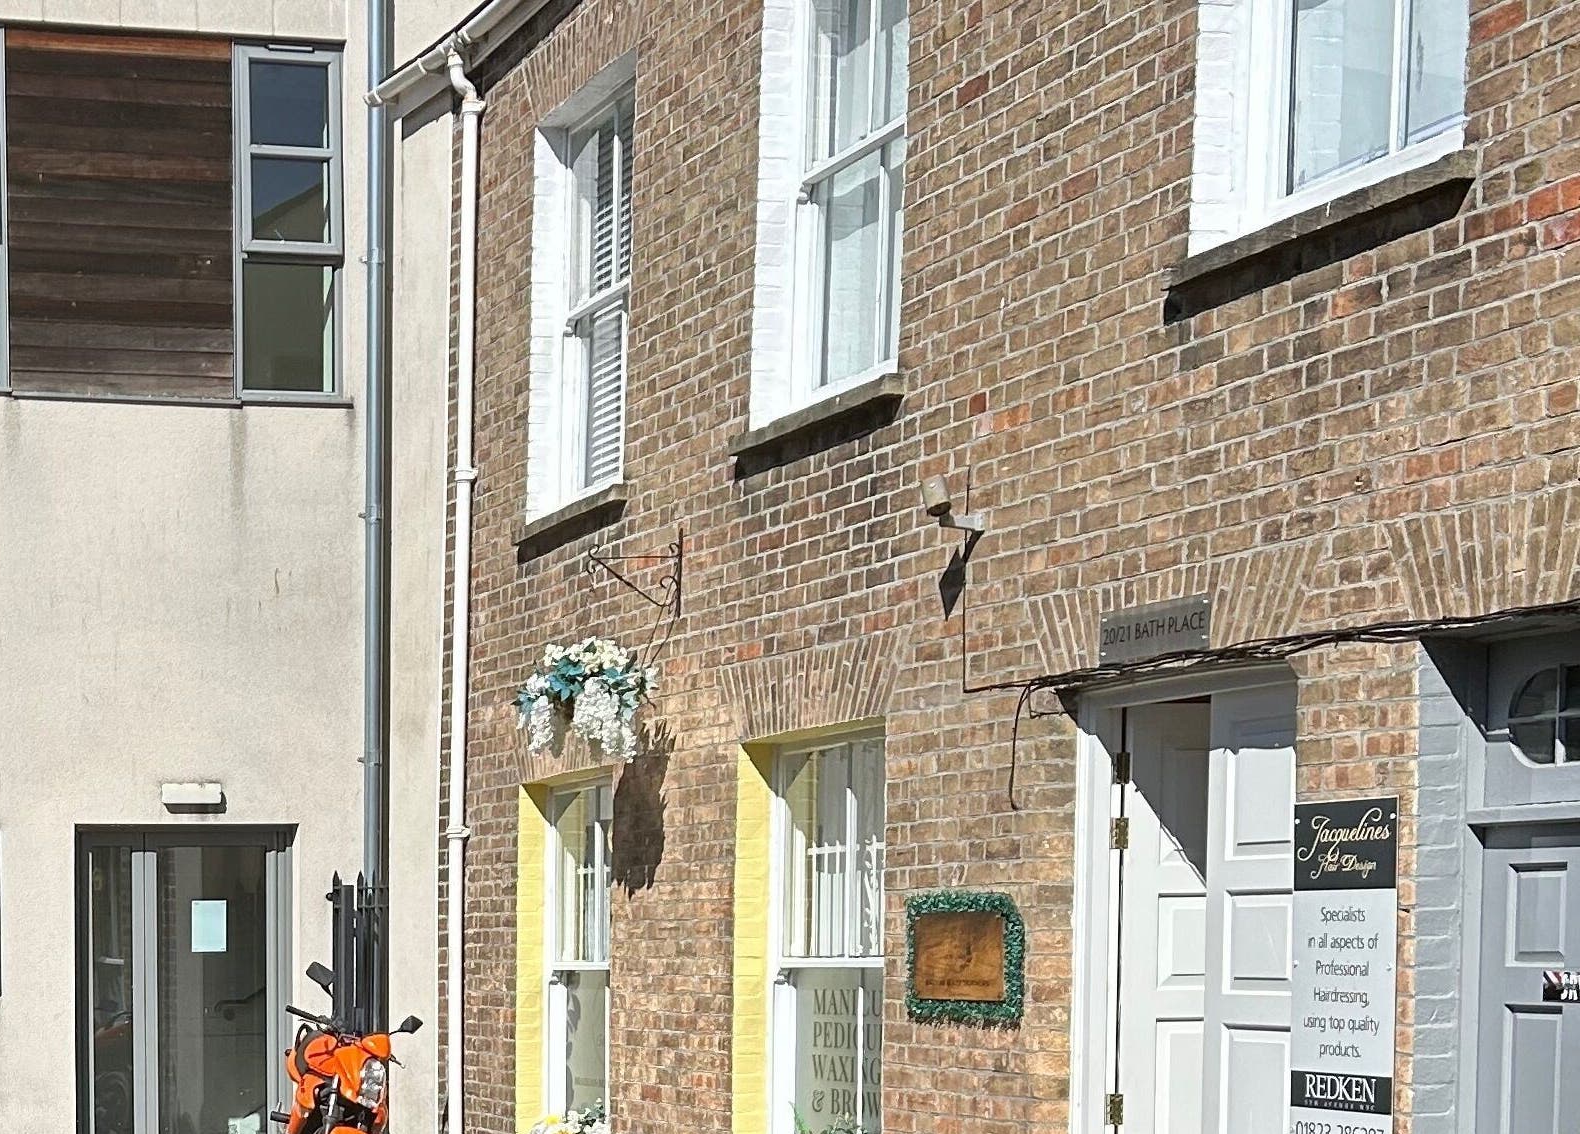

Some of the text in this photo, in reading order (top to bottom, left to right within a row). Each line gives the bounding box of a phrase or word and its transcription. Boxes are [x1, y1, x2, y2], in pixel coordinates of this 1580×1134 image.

[1103, 611, 1206, 646] 20/21 BATH PLACE
[1297, 807, 1391, 861] Jacquelines
[1310, 852, 1377, 880] Hair Design
[1321, 906, 1366, 927] Specialists
[1308, 932, 1380, 952] in all aspects of
[1315, 959, 1370, 977] Professional
[1313, 986, 1370, 1008] Hairdressing,
[1303, 1012, 1380, 1037] using top quality
[1319, 1041, 1362, 1059] products.
[811, 1054, 881, 1086] WAXING
[1304, 1074, 1377, 1103] REDKEN
[812, 1090, 825, 1113] &
